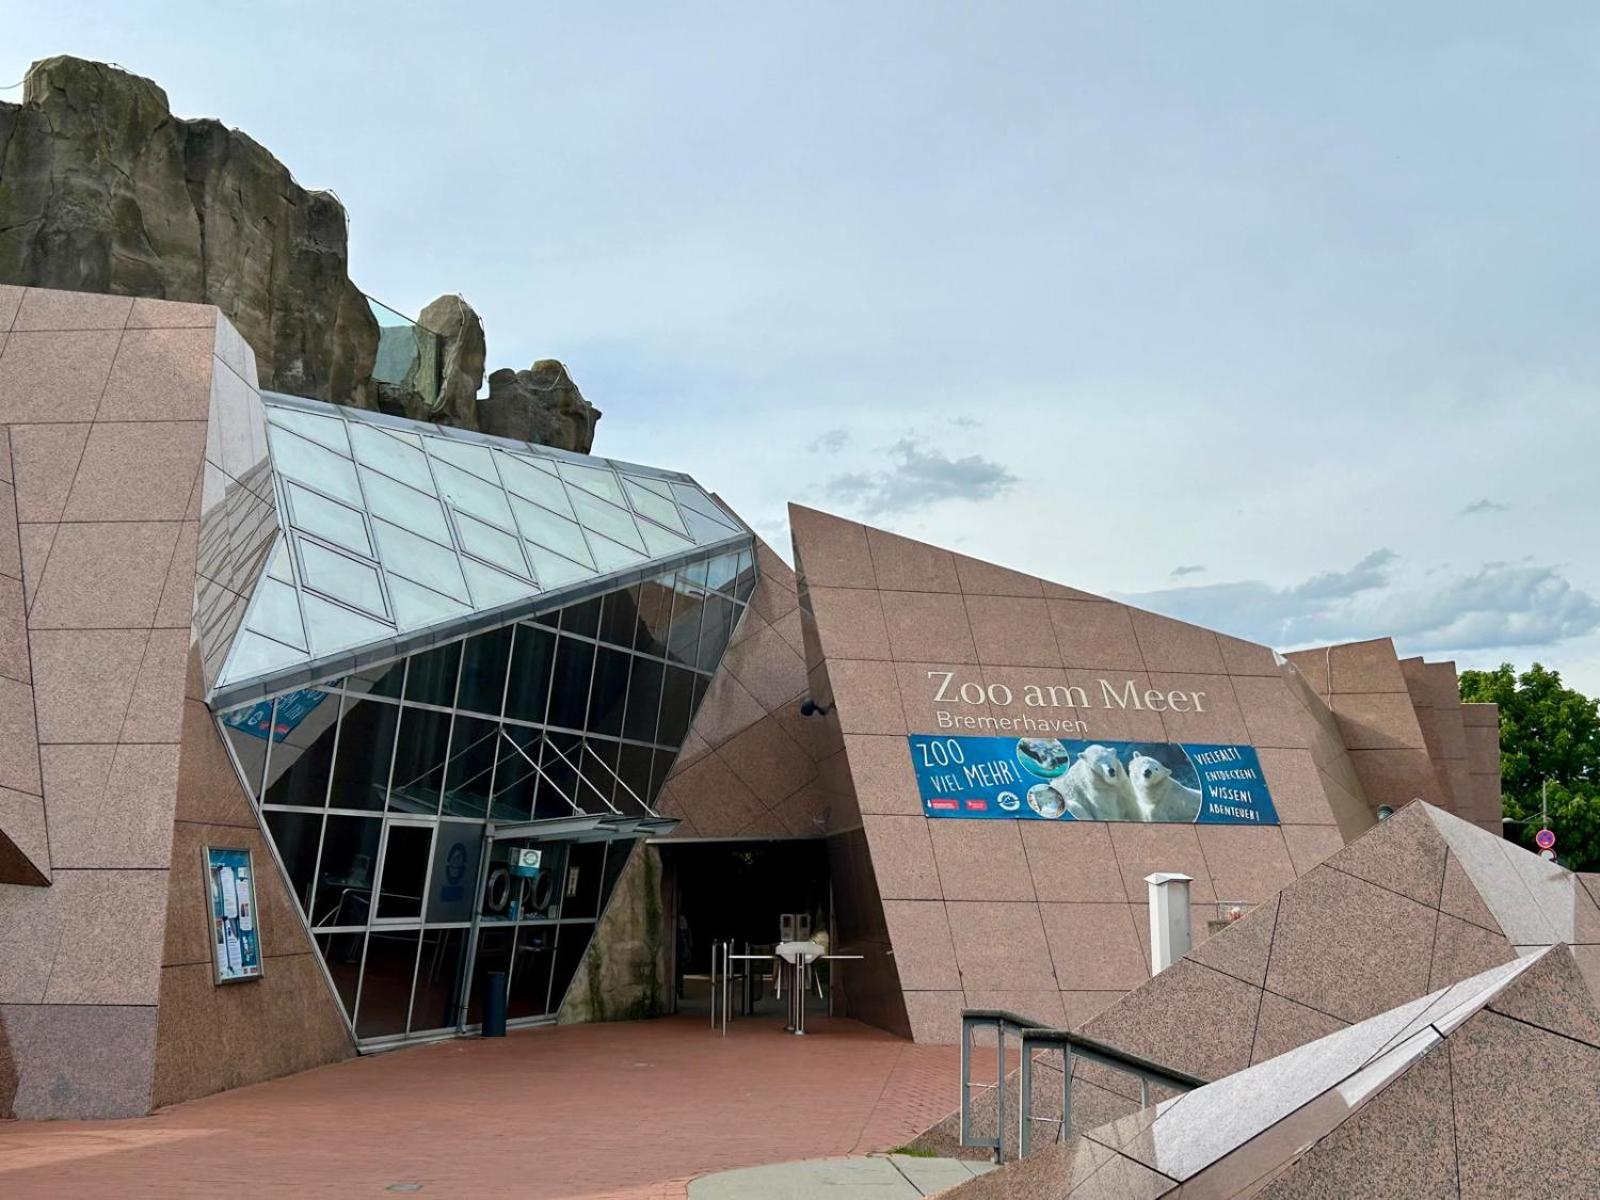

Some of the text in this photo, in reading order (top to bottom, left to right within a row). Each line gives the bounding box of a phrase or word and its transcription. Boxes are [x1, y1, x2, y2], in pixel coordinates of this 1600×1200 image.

[928, 672, 1207, 713] Zoo am Meer
[936, 711, 1089, 733] Bremerhaven
[916, 739, 964, 767] ZOO
[930, 759, 1023, 793] VIEL MEHR!
